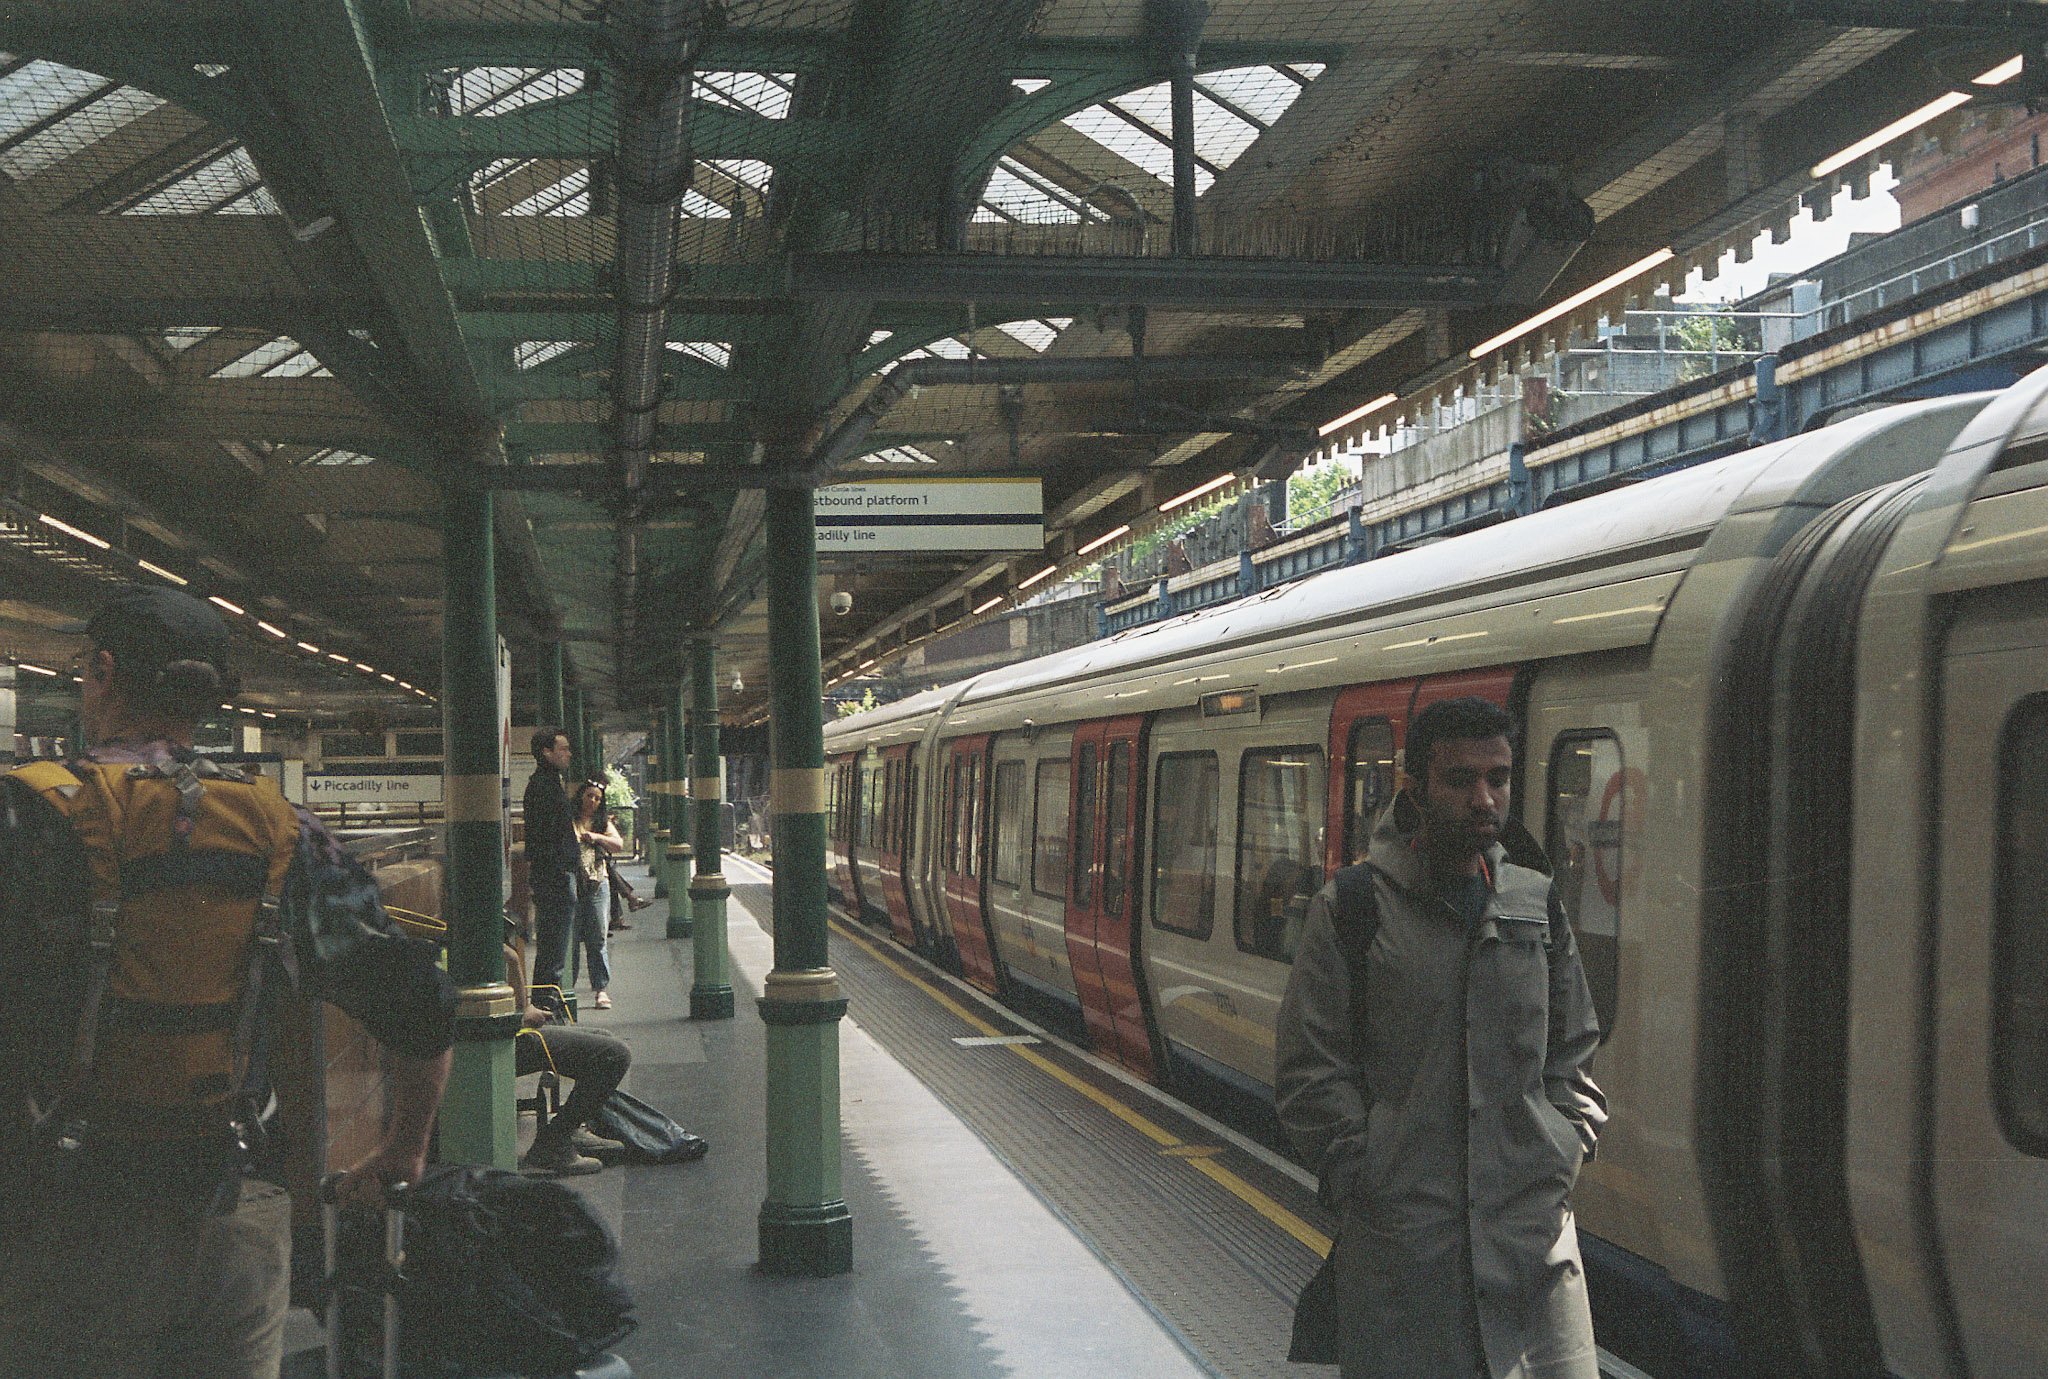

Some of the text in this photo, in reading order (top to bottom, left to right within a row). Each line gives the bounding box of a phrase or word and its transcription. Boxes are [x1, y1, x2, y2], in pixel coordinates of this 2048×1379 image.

[813, 495, 928, 508] stbound platform 1
[815, 529, 876, 542] adilly line
[324, 780, 409, 792] Piccadilly line
